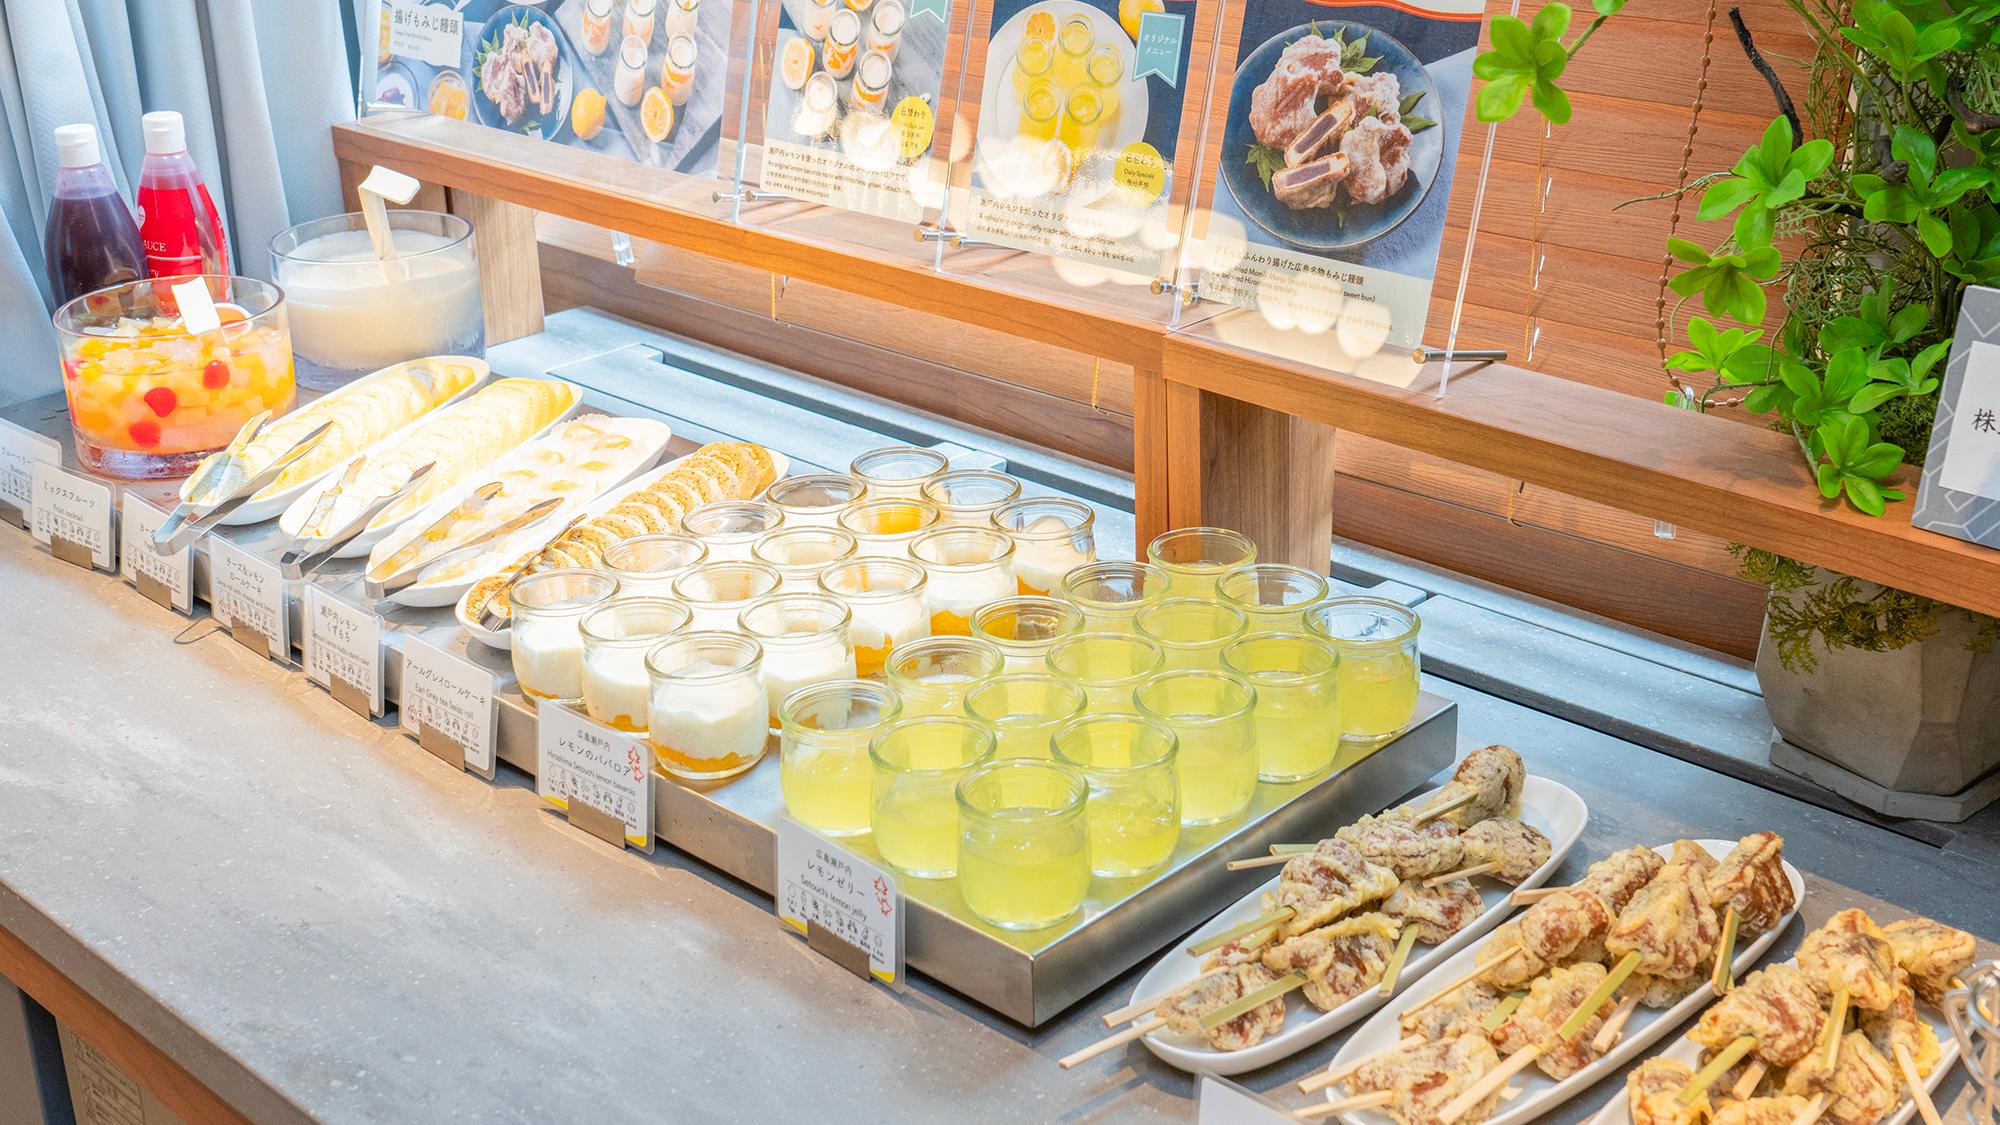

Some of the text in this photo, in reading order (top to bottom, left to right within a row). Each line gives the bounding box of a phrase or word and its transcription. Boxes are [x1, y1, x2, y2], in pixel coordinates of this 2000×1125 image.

[394, 8, 459, 35] 揚げもみじ饅頭
[1143, 32, 1177, 45] オリジナル
[1145, 47, 1172, 55] メニュー
[1124, 168, 1135, 177] Daily
[1971, 408, 2000, 435] 株
[43, 480, 95, 508] ミックスフルーツ
[320, 605, 359, 632] 瀬戸内レモン
[406, 658, 486, 708] アールグレイロールケーキ
[415, 682, 425, 694] Earl
[426, 688, 438, 703] Grey
[440, 697, 448, 707] tea
[464, 710, 474, 720] roll
[577, 729, 611, 752] 広島瀬戸内
[546, 749, 572, 767] Hiroshima
[573, 760, 595, 779] Setouchi
[595, 771, 612, 786] lemon
[815, 848, 853, 877] 広島瀬戸内
[807, 860, 866, 897] レモンゼリー
[801, 874, 867, 921] Setouchi lemon jelly
